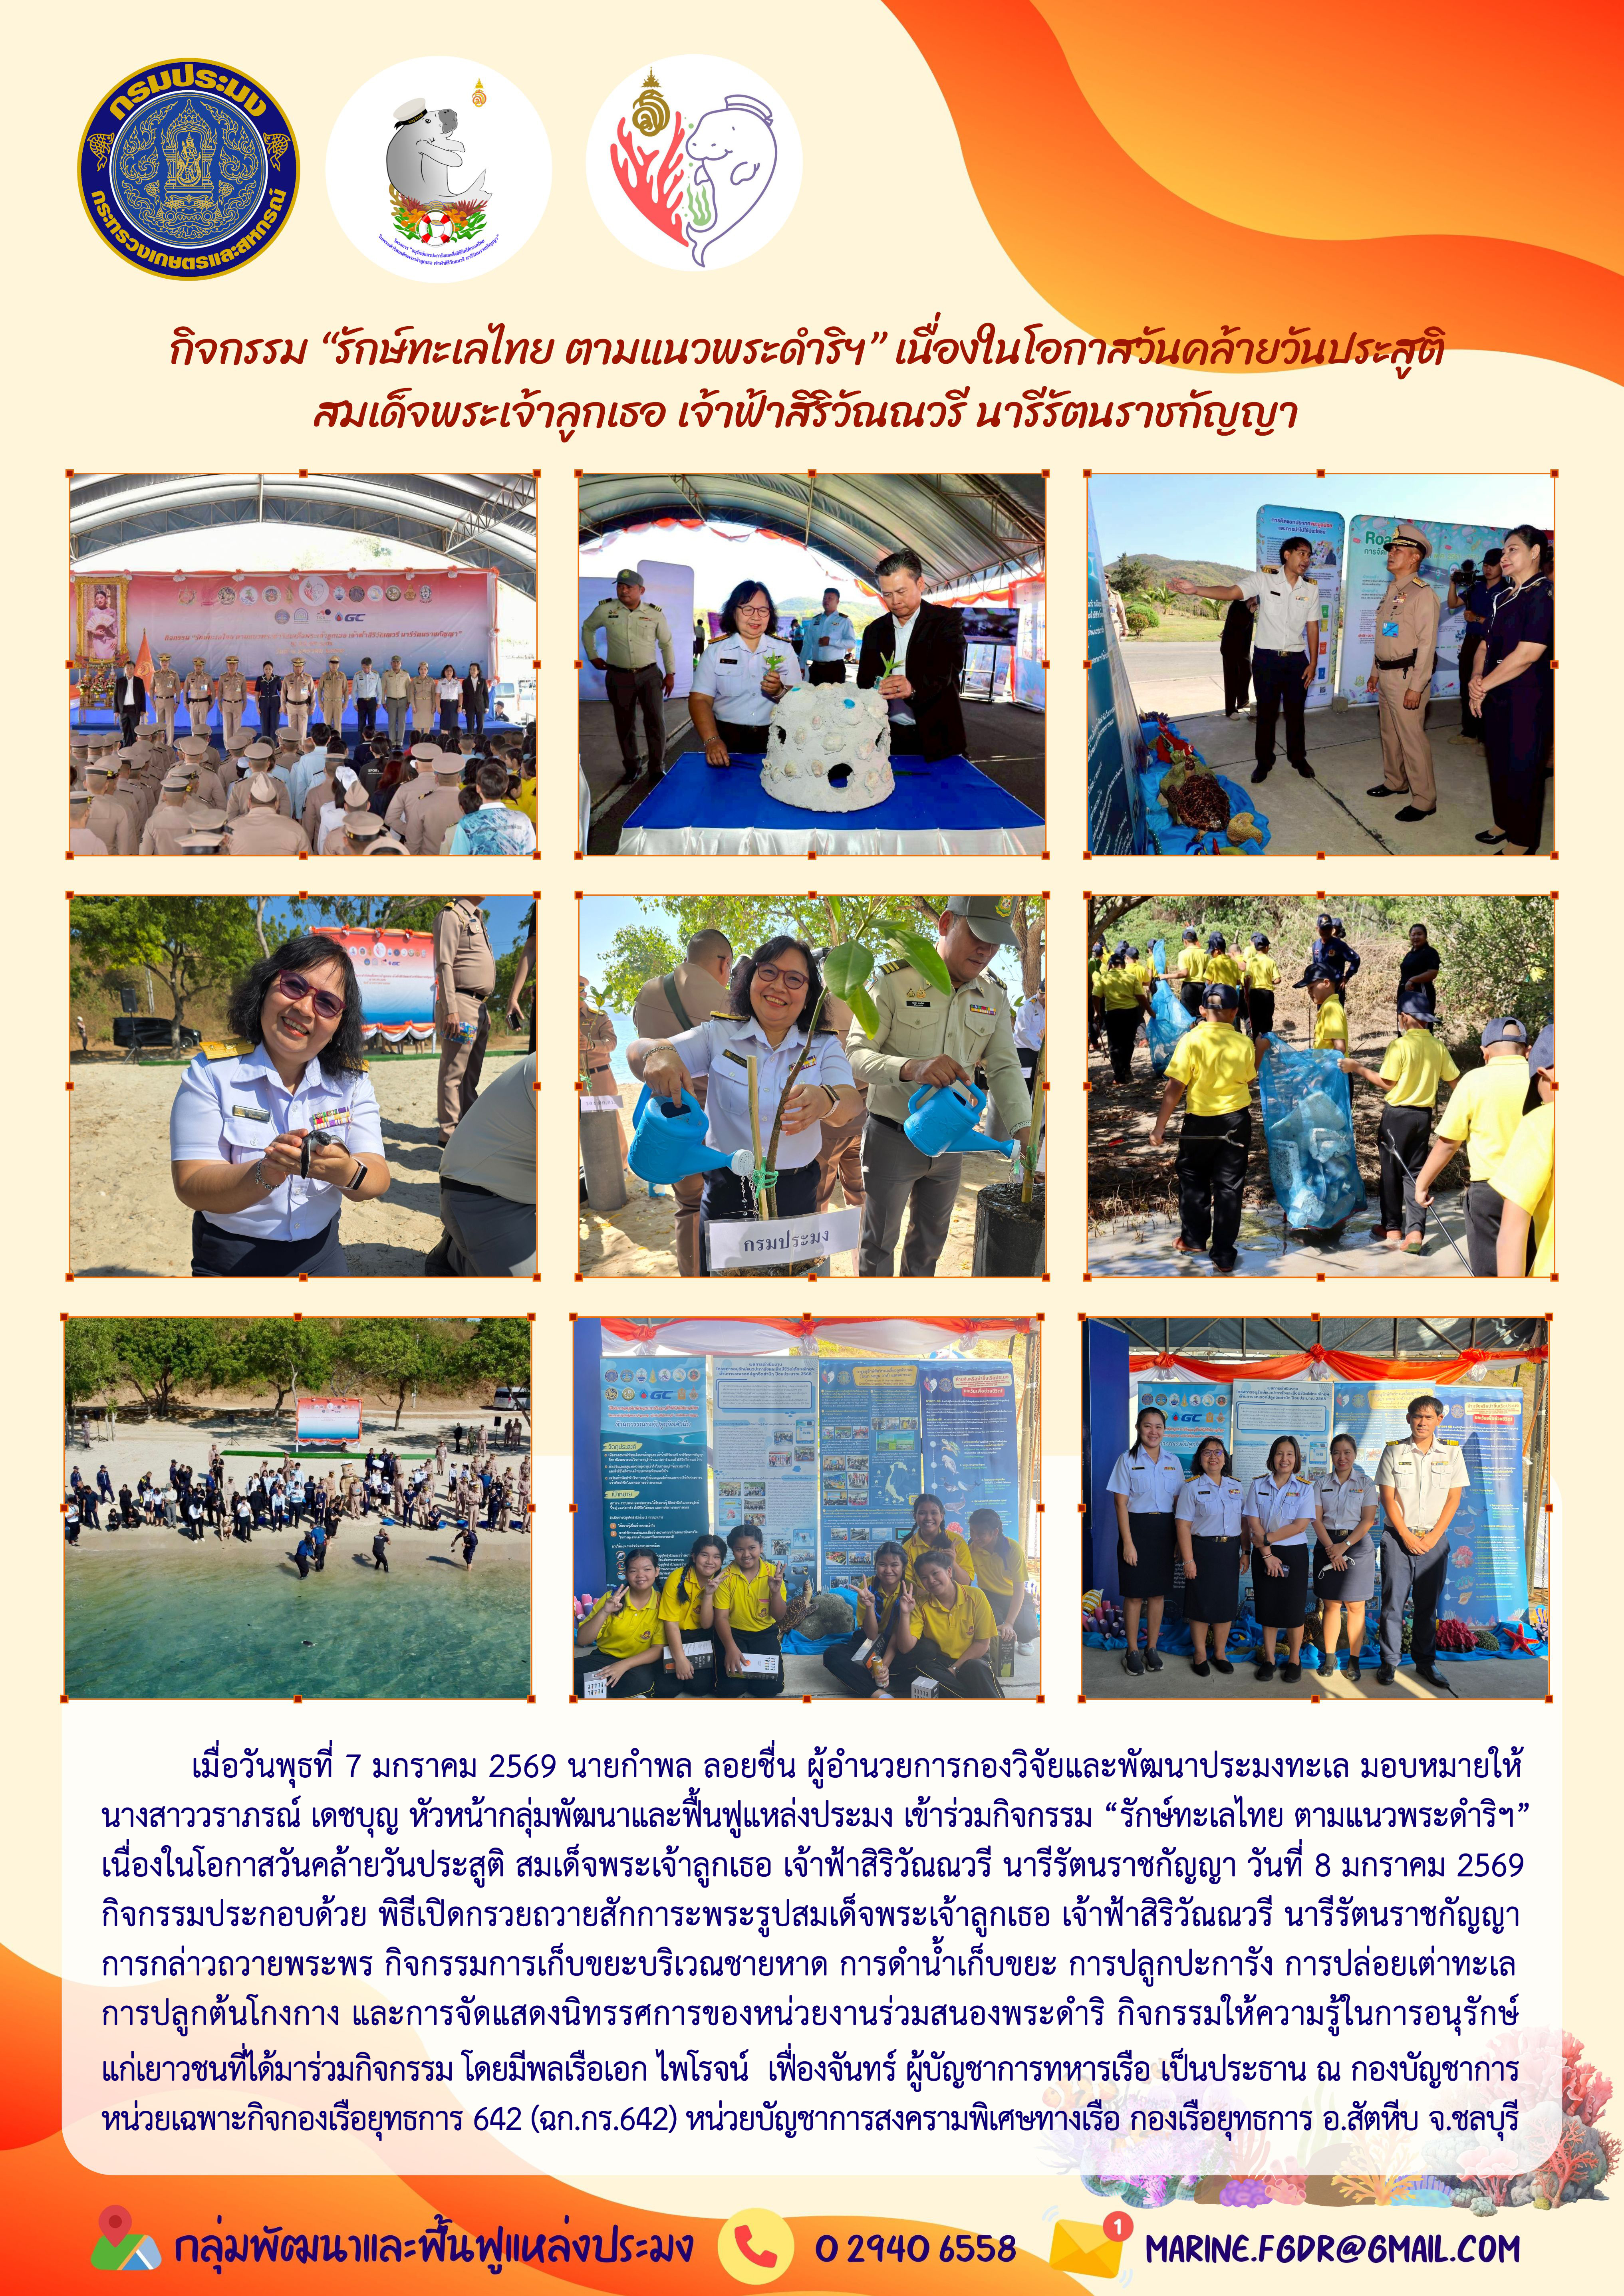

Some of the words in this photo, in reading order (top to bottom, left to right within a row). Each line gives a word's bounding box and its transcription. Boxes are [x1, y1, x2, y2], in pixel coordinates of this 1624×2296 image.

[110, 64, 266, 121] กรมประมง
[91, 189, 287, 270] กระทรวงเกษตรและสหกรณ์
[394, 238, 408, 250] โครงการ
[171, 327, 308, 365] กิจกรรม
[323, 323, 554, 365] “รักษ์ทะเลไทย
[566, 327, 887, 365] ตามแนวพระดำริฯ”
[896, 312, 1445, 379] เนื่องในโอกาสวันคล้ายวันประสูติ
[314, 388, 665, 442] สมเด็จพระเจ้าลูกเธอ
[679, 386, 970, 428] เจ้าฟ้าสิริวัณณวรี
[977, 386, 1297, 436] นารีรัตนราชกัญญา
[1278, 526, 1326, 534] และการนำไปใช้ประโยชน์
[1366, 531, 1393, 545] Roa
[344, 614, 366, 622] GC
[744, 1228, 829, 1252] กรมประมง
[650, 1390, 673, 1400] GC
[615, 1420, 691, 1429] ด้านการรณรงค์ปลูกจิตสำนึก
[194, 1740, 332, 1788] เมื่อวันพุธที่
[346, 1755, 361, 1777] 7
[373, 1758, 475, 1778] มกราคม
[489, 1754, 556, 1778] 2569
[568, 1748, 691, 1778] นายกำพล
[705, 1740, 795, 1778] ลอยชื่น
[809, 1746, 1348, 1788] ผู้อำนวยการกองวิจัยและพัฒนาประมงทะเล
[1361, 1746, 1524, 1778] มอบหมายให้
[102, 1796, 301, 1827] นางสาววราภรณ์
[313, 1807, 398, 1838] เดชบุญ
[410, 1787, 892, 1838] หัวหน้ากลุ่มพัฒนาและฟื้นฟูแหล่งประมง
[906, 1796, 1091, 1827] เข้าร่วมกิจกรรม
[1106, 1795, 1282, 1827] “รักษ์ทะเลไทย
[1295, 1798, 1529, 1827] ตามแนวพระดำริฯ”
[103, 1839, 503, 1888] เนื่องในโอกาสวันคล้ายวันประสูติ
[516, 1844, 770, 1888] สมเด็จพระเจ้าลูกเธอ
[785, 1845, 991, 1877] เจ้าฟ้าสิริวัณณวรี
[1004, 1846, 1235, 1884] นารีรัตนราชกัญญา
[1248, 1839, 1302, 1877] วันที่
[1316, 1853, 1330, 1877] 8
[1342, 1857, 1444, 1877] มกราคม
[1457, 1853, 1523, 1877] 2569
[103, 1895, 365, 1926] กิจกรรมประกอบด้วย
[379, 1893, 1049, 1937] พิธีเปิดกรวยถวายสักการะพระรูปสมเด็จพระเจ้าลูกเธอ
[1064, 1895, 1272, 1926] เจ้าฟ้าสิริวัณณวรี
[1285, 1895, 1518, 1934] นารีรัตนราชกัญญา
[103, 1946, 372, 1976] การกล่าวถวายพระพร
[386, 1943, 826, 1976] กิจกรรมการเก็บขยะบริเวณชายหาด
[841, 1936, 1056, 1976] การดำน้ำเก็บขยะ
[1070, 1946, 1272, 1987] การปลูกปะการัง
[1286, 1946, 1514, 1976] การปล่อยเต่าทะเล
[103, 1994, 338, 2036] การปลูกต้นโกงกาง
[354, 1995, 1104, 2025] และการจัดแสดงนิทรรศการของหน่วยงานร่วมสนองพระดำริ
[1118, 1994, 1519, 2036] กิจกรรมให้ความรู้ในการอนุรักษ์
[103, 2043, 452, 2081] แก่เยาวชนที่ได้มาร่วมกิจกรรม
[461, 2050, 646, 2081] โดยมีพลเรือเอก
[656, 2049, 748, 2081] ไพโรจน์
[770, 2043, 897, 2081] เฟื่องจันทร์
[907, 2050, 1149, 2092] ผู้บัญชาการทหารเรือ
[1163, 2048, 1306, 2081] เป็นประธาน
[1317, 2061, 1340, 2081] ณ
[1352, 2051, 1519, 2088] กองบัญชาการ
[102, 2099, 463, 2141] หน่วยเฉพาะกิจกองเรือยุทธการ
[474, 2107, 521, 2130] 642
[532, 2105, 676, 2133] (ฉก.กร.642)
[686, 2099, 1119, 2138] หน่วยบัญชาการสงครามพิเศษทางเรือ
[1131, 2099, 1312, 2141] กองเรือยุทธการ
[1323, 2099, 1418, 2130] อ.สัตหีบ
[1429, 2099, 1519, 2141] จ.ชลบุรี
[176, 2214, 693, 2274] กลุ่มพัฒนาและฟื้นฟูแหล่งประมง
[848, 2235, 929, 2262] 2940
[940, 2235, 1016, 2262] 6558
[1147, 2235, 1519, 2263] MARINE.FGDR@GMAIL.COM
